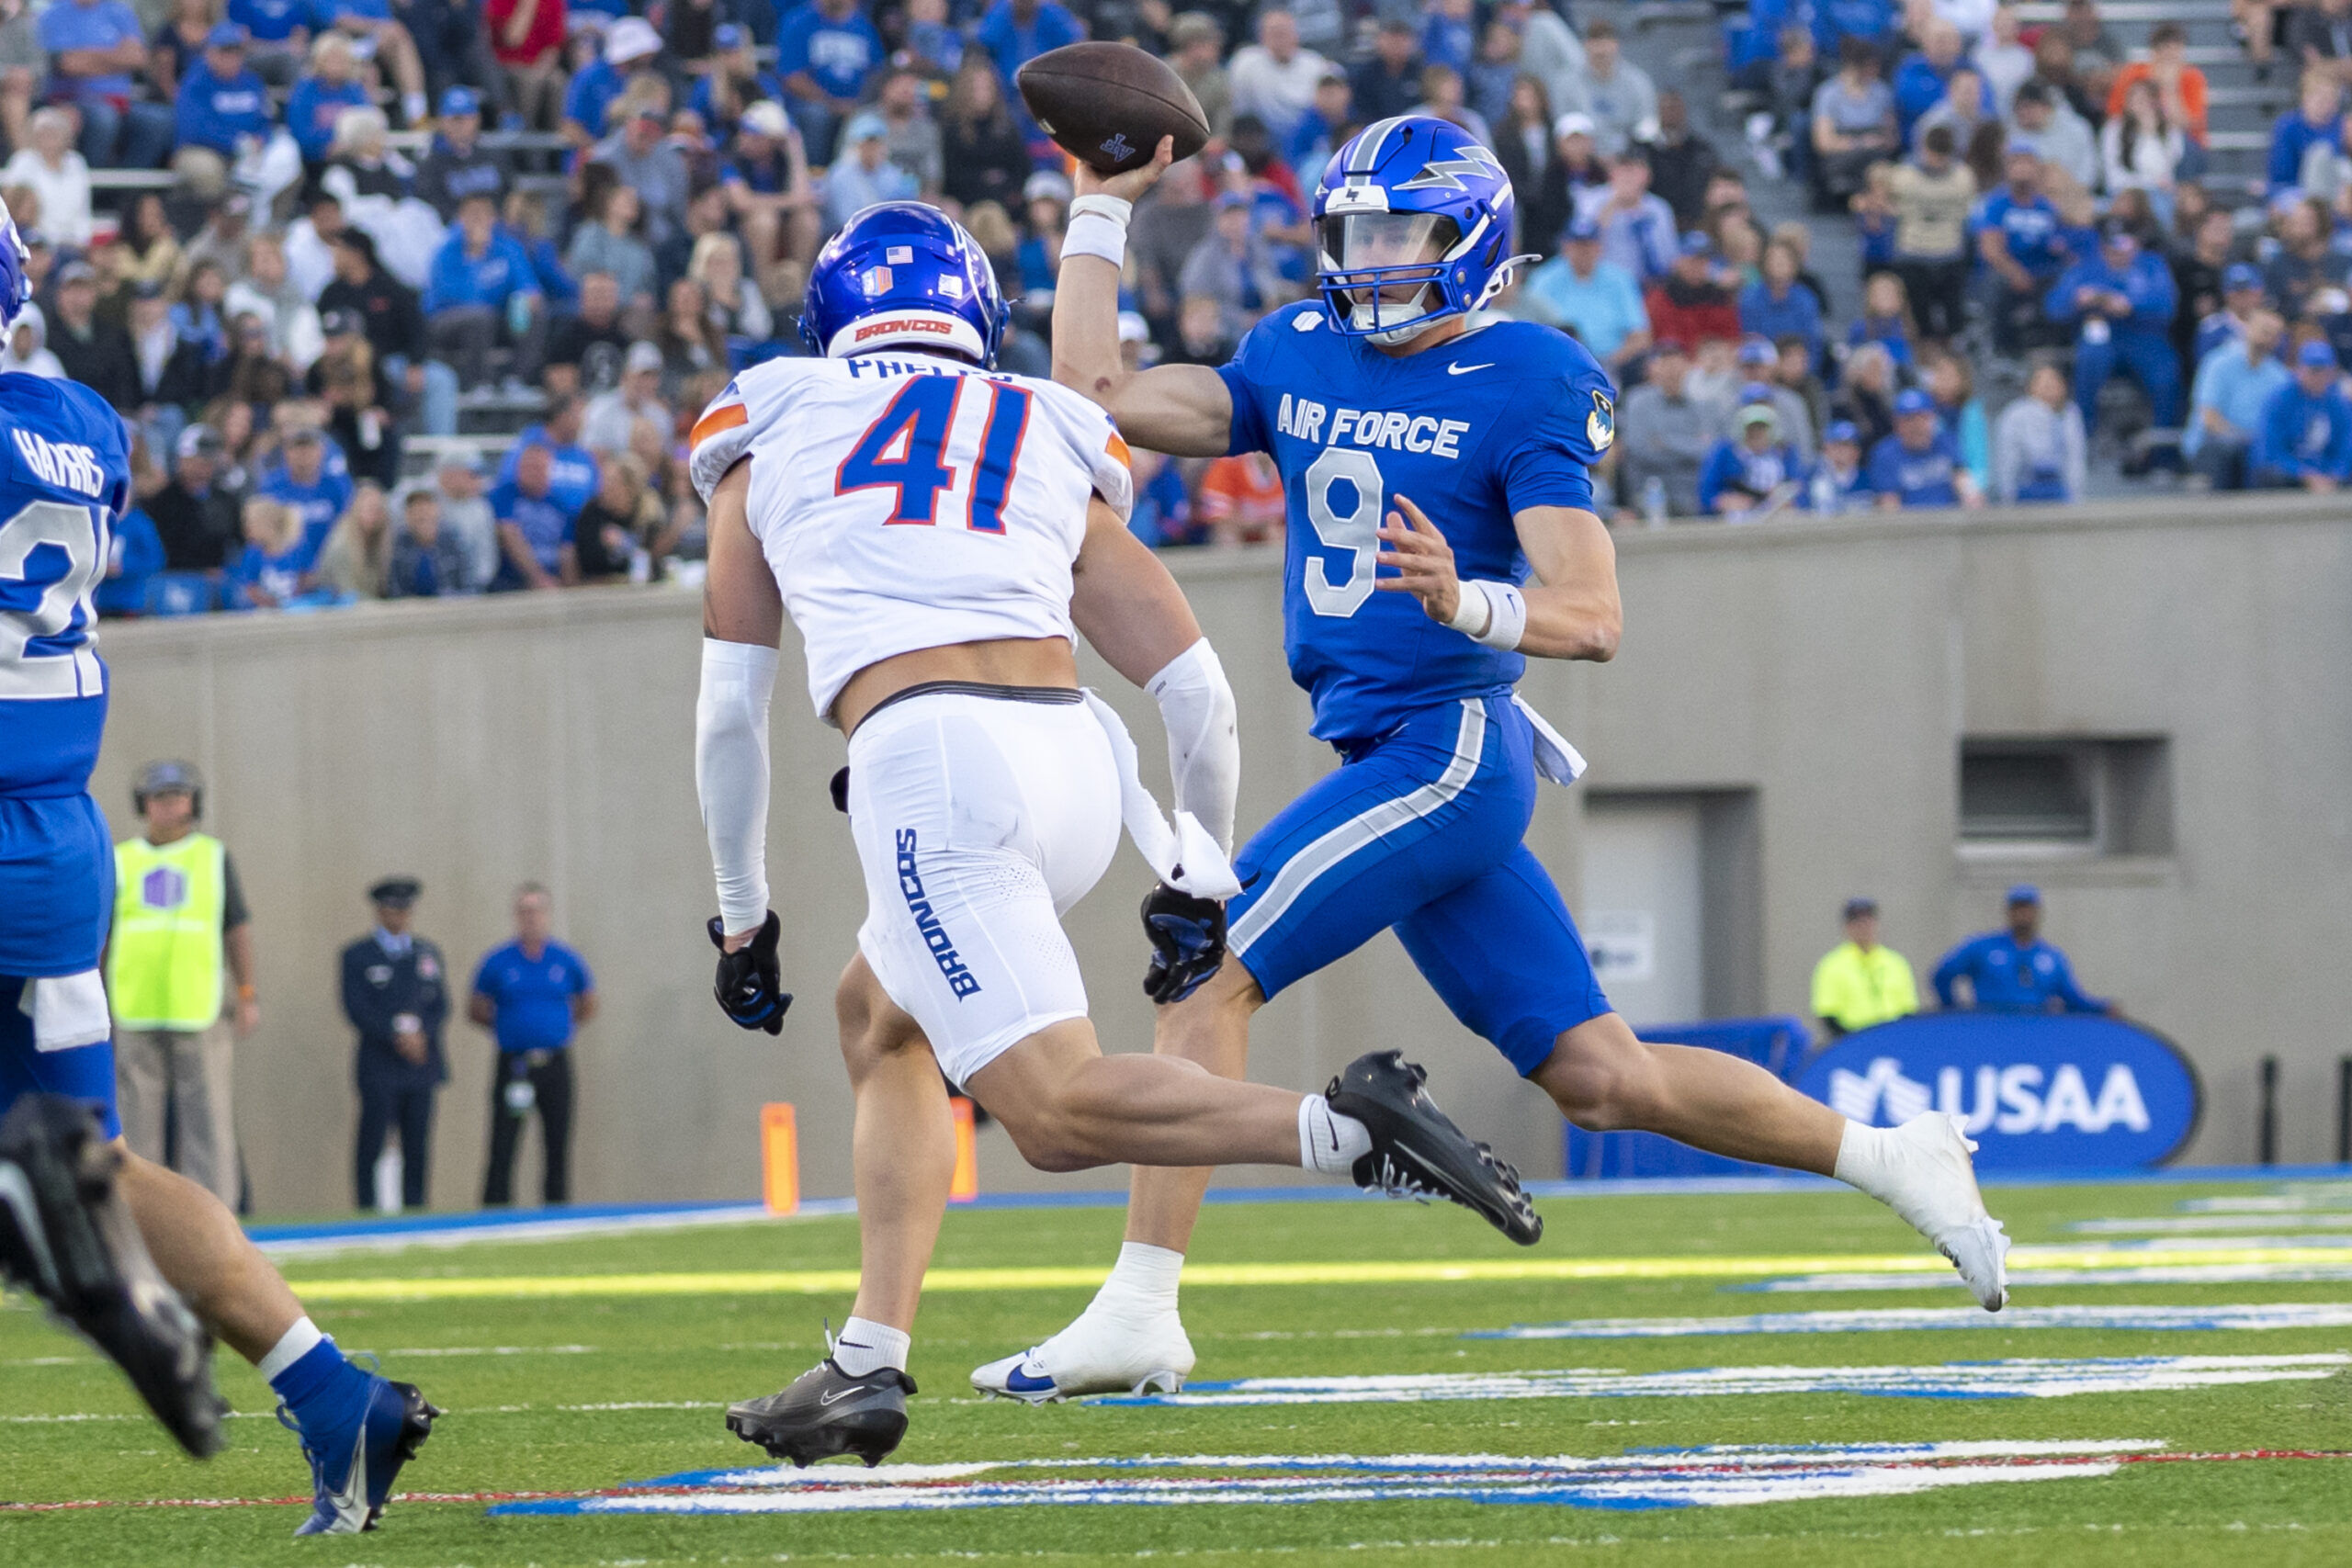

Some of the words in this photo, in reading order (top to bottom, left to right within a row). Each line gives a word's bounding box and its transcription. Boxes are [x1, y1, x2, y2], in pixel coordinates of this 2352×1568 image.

[854, 319, 954, 343] BRONCOS
[847, 358, 1013, 383] PHE
[834, 373, 1034, 536] 41
[1277, 392, 1327, 444] AIR
[1327, 408, 1470, 459] FORCE
[12, 427, 105, 498] HARRIS
[1304, 446, 1384, 618] 9
[896, 828, 982, 1003] BRONCOS
[1937, 1063, 2151, 1134] USAA
